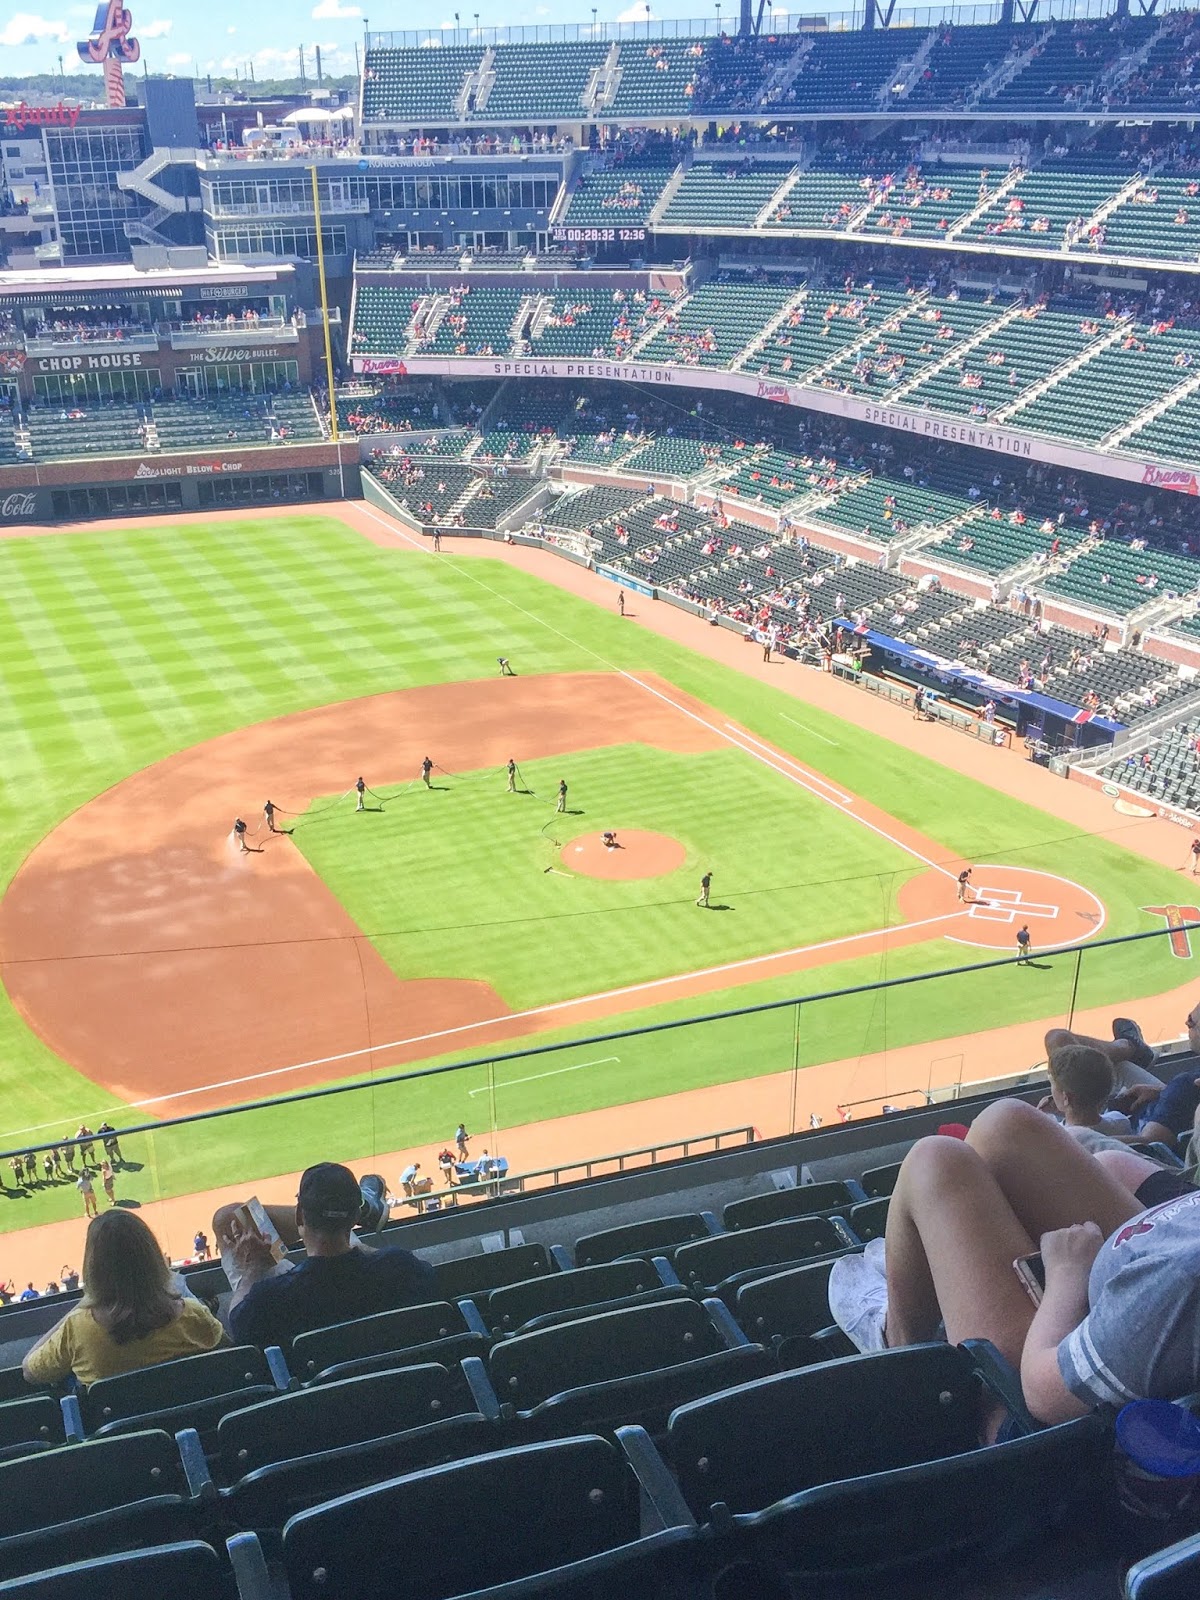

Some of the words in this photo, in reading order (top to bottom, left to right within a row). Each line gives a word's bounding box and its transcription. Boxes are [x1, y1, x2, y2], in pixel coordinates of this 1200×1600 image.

[368, 159, 400, 168] KONICA
[400, 158, 436, 168] MINOLTA
[567, 229, 615, 241] 00:28:32
[618, 229, 645, 241] 12:36
[222, 287, 246, 296] BURGER
[190, 353, 204, 361] THE
[204, 346, 251, 362] Silver
[39, 356, 83, 371] CHOP
[89, 353, 142, 369] HOUSE
[362, 359, 399, 374] Braves
[494, 363, 558, 375] SPECIAL
[567, 364, 672, 382] PRESENTATION
[865, 407, 917, 430] SPECIAL
[924, 420, 1032, 455] PRESENTATION
[1141, 464, 1190, 484] Braves
[160, 467, 182, 476] LIGHT
